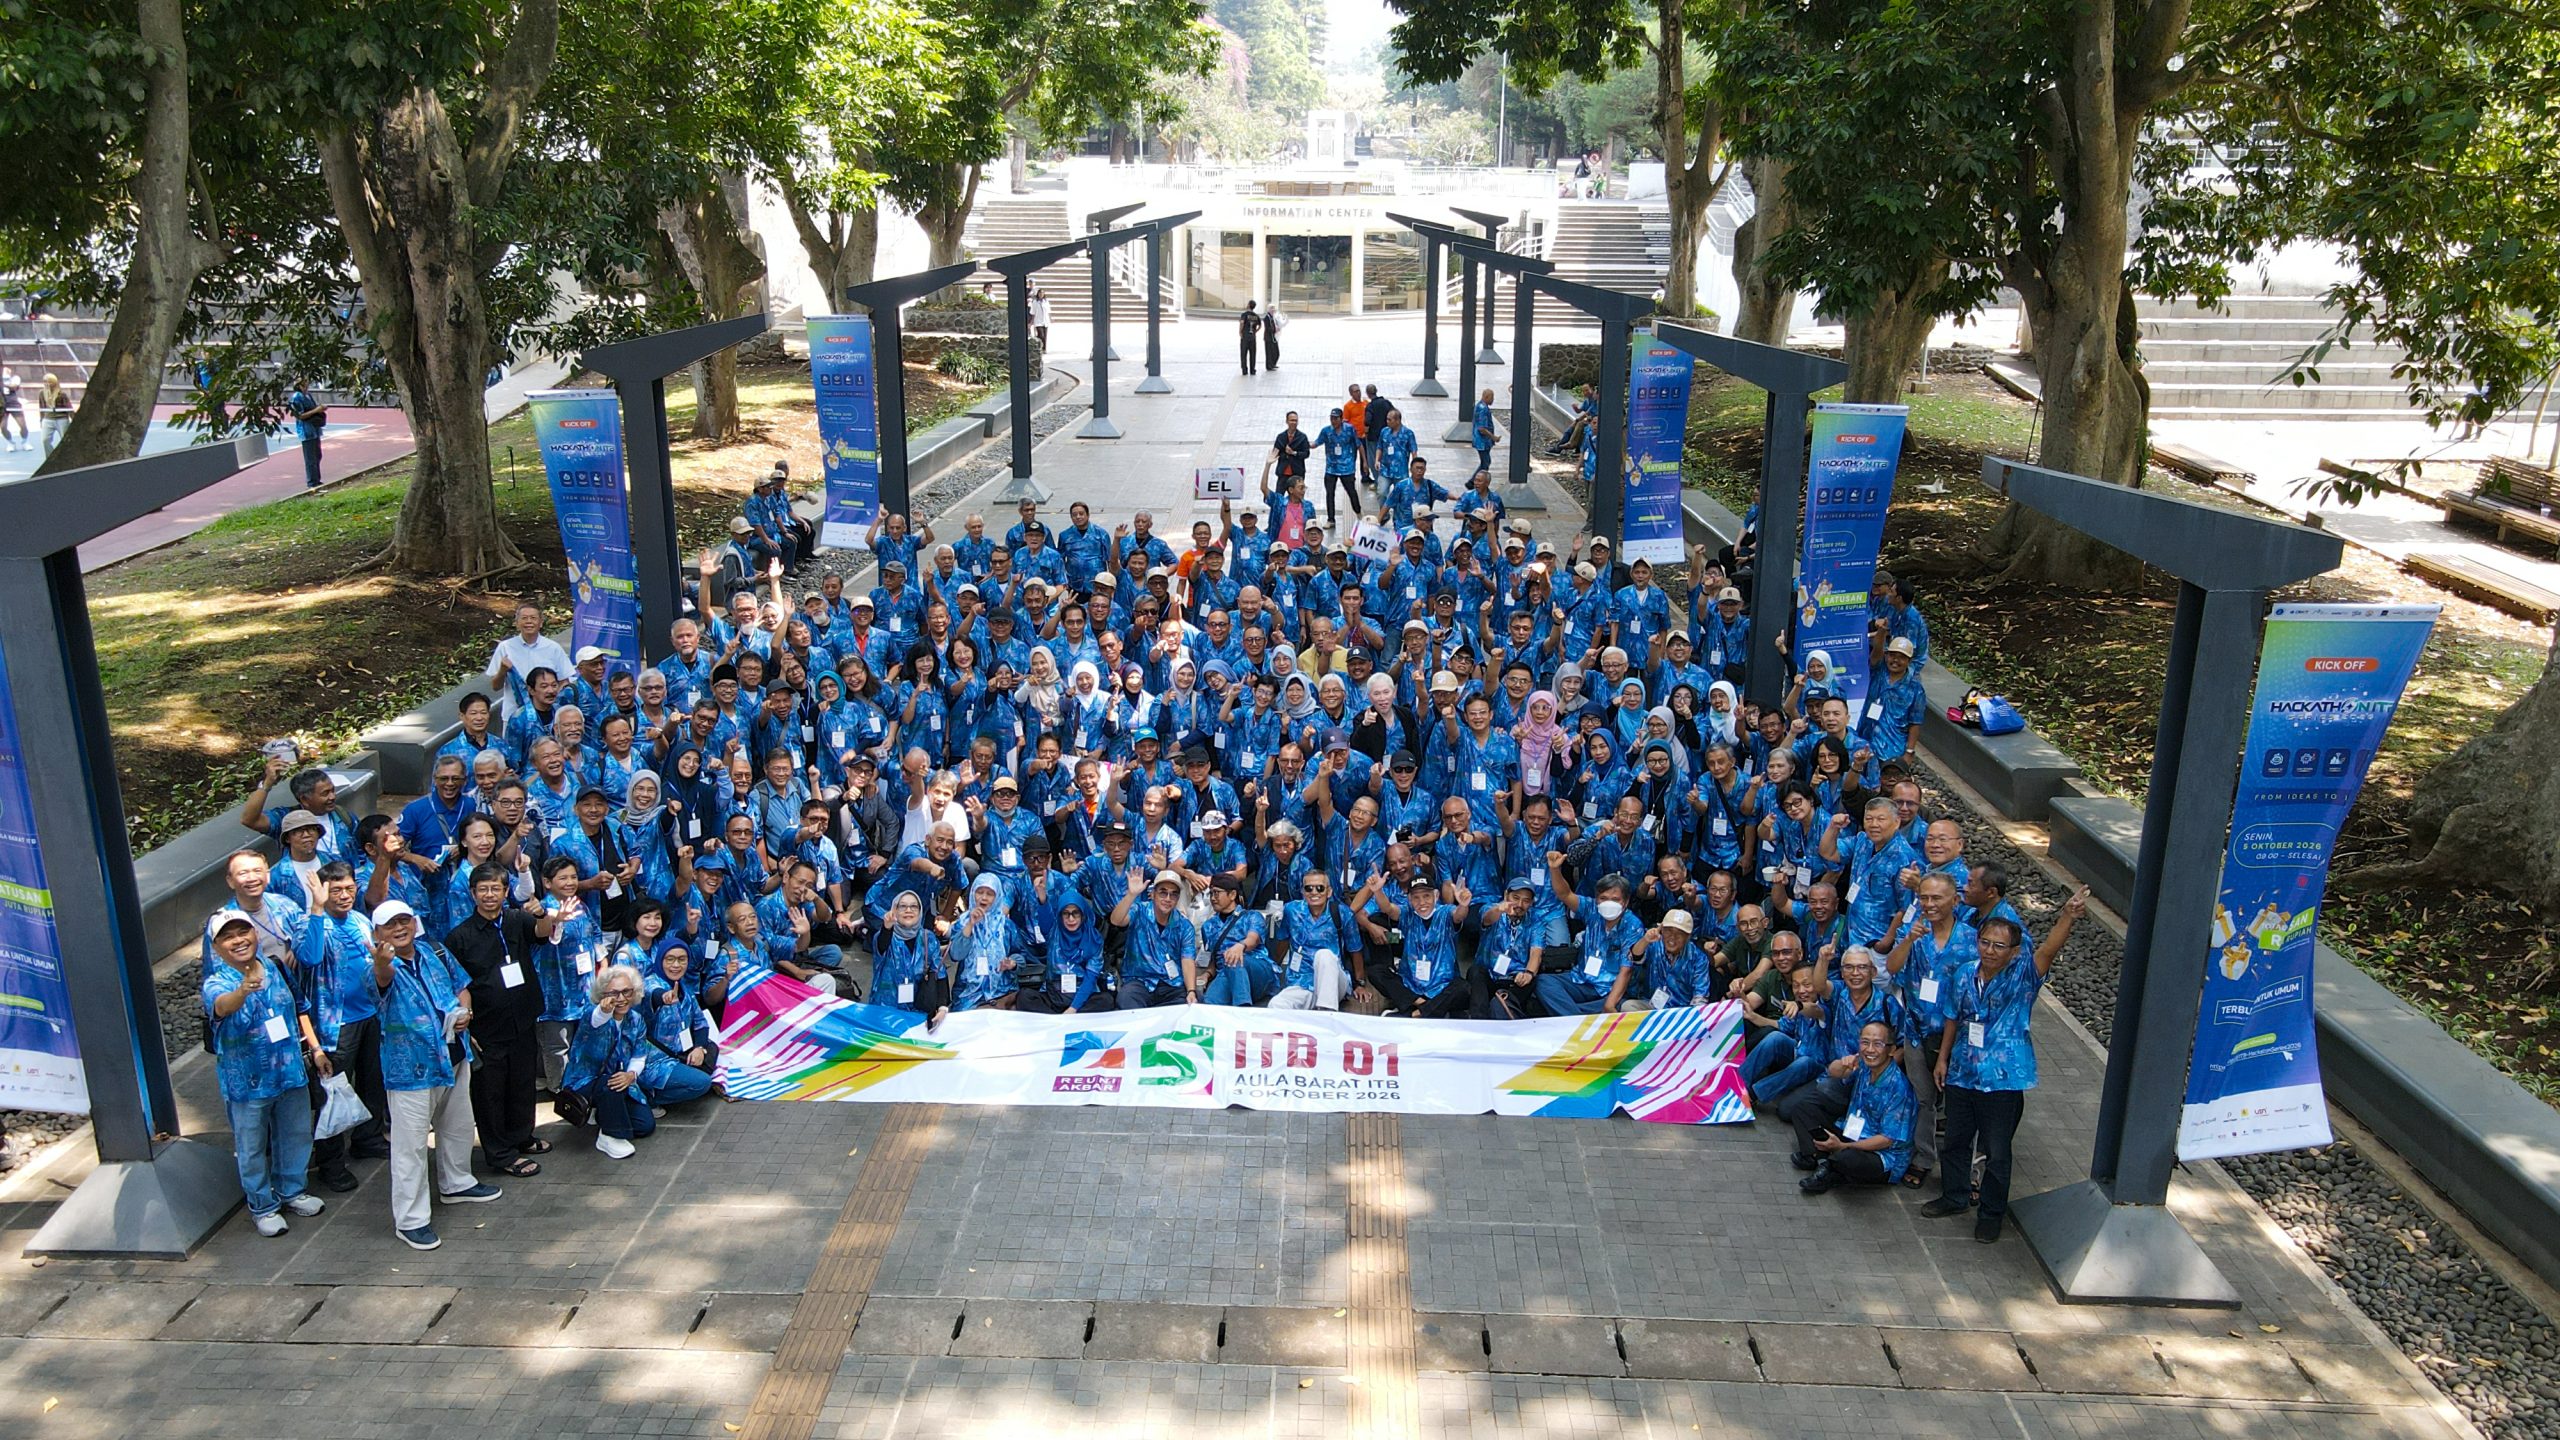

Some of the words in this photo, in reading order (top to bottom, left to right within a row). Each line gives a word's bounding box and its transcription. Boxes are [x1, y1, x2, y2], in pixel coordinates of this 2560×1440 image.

[1243, 207, 1322, 218] INFORMATION
[1329, 208, 1373, 218] CENTER
[1207, 481, 1232, 492] EL
[1358, 536, 1388, 553] MS
[1823, 594, 1863, 605] RATUSAN
[1802, 640, 1825, 650] TERBUKA
[1825, 638, 1843, 648] UNTUK
[2314, 660, 2340, 671] KICK
[2343, 660, 2367, 671] OFF
[2254, 793, 2283, 801] FROM
[2324, 793, 2338, 801] TO
[2243, 832, 2274, 842] SENIN,
[2251, 842, 2294, 850] OKTOBER
[2296, 841, 2322, 851] 2026
[2287, 852, 2322, 861] SELESAI
[4, 900, 23, 912] JUTA
[11, 951, 33, 965] UNTUK
[2274, 982, 2299, 997] UMUM
[1192, 1026, 1214, 1036] TH
[1234, 1030, 1318, 1069] ITB
[1343, 1040, 1399, 1077] 01
[1060, 1075, 1117, 1085] REUNI
[1234, 1073, 1288, 1087] AULA
[1295, 1075, 1365, 1089] BARAT
[1368, 1079, 1400, 1090] ITB
[1059, 1083, 1115, 1092] AKBAR
[1233, 1088, 1243, 1096] 3
[1249, 1088, 1348, 1100] OKTOBER
[1356, 1091, 1401, 1100] 2026
